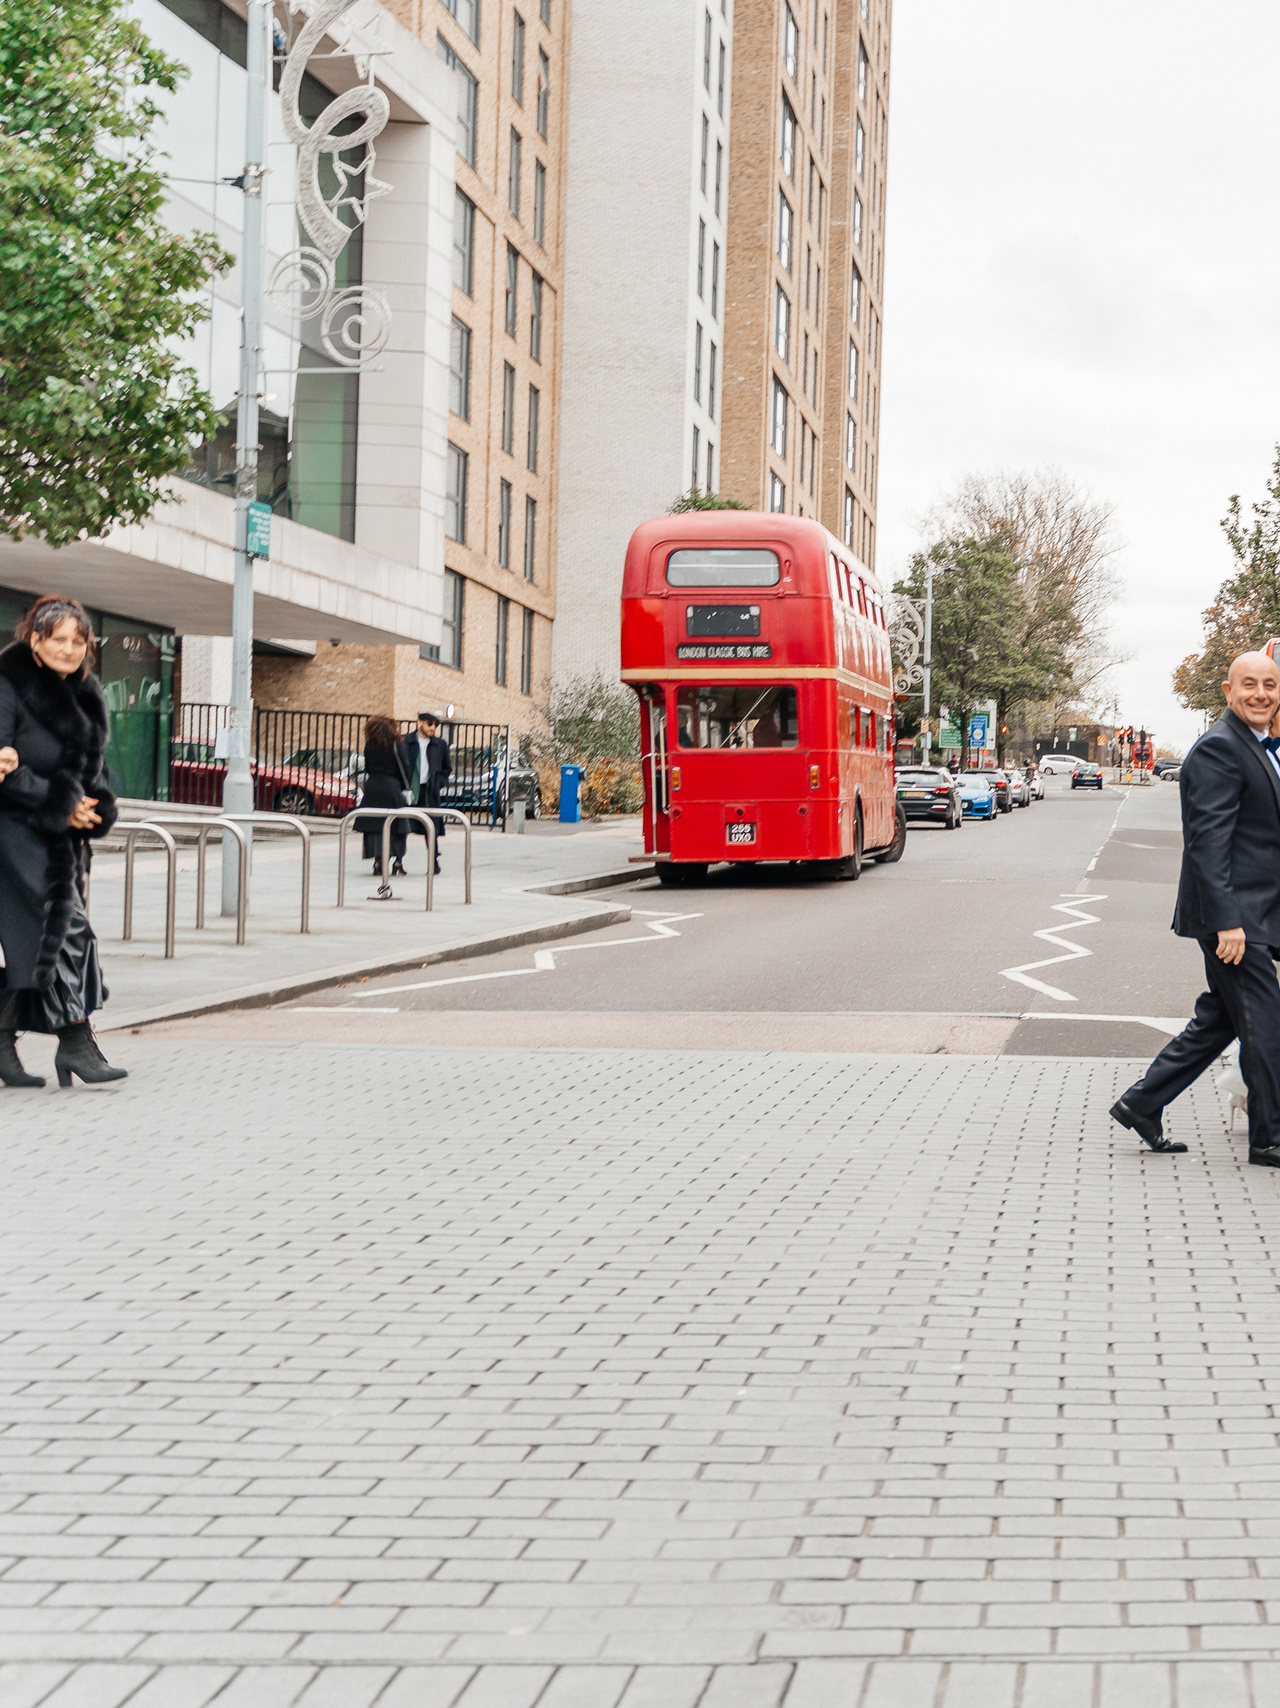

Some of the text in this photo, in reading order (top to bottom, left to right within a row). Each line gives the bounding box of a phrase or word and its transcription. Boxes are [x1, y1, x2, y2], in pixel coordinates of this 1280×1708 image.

[679, 645, 769, 659] LONDON CLASSIC BUS HIRE
